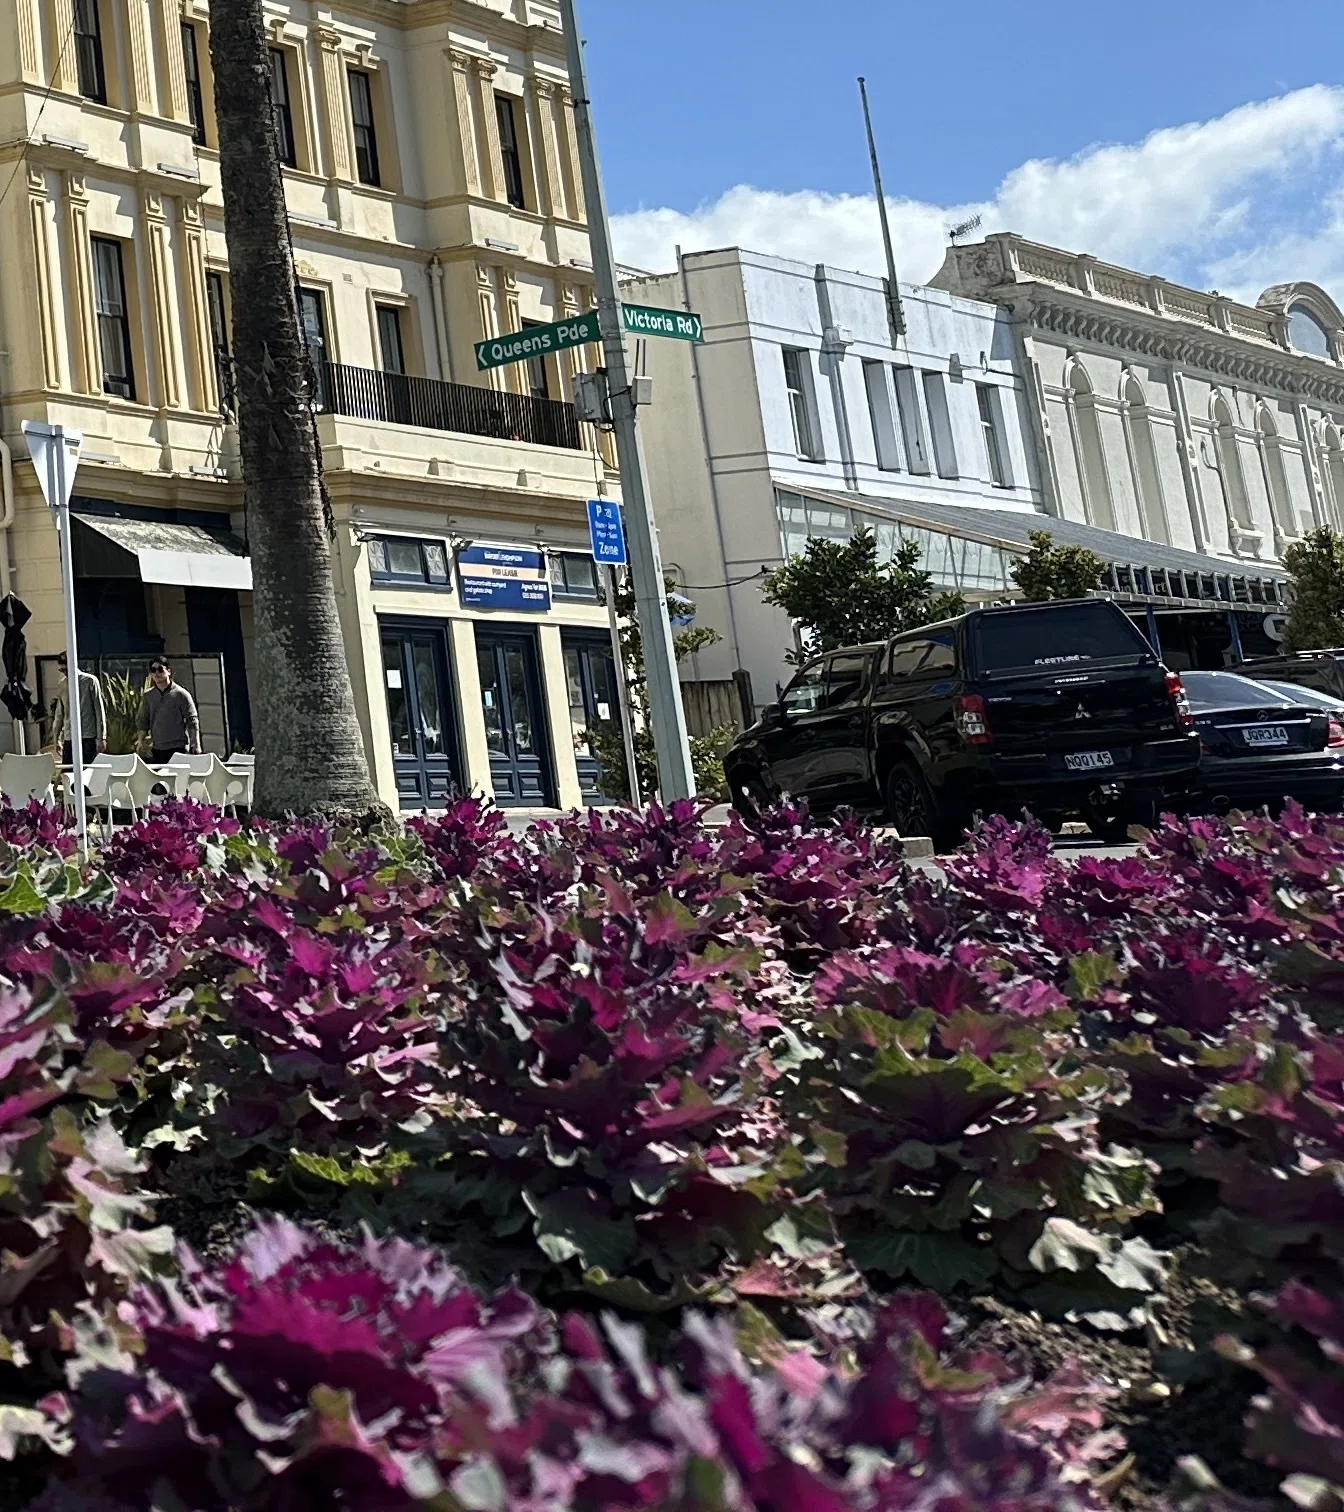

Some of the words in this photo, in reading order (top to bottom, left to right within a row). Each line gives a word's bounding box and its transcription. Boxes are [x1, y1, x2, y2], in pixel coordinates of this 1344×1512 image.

[624, 308, 674, 332] Victoria
[676, 316, 694, 335] Rd
[491, 332, 552, 359] Queens
[556, 321, 589, 344] Pde
